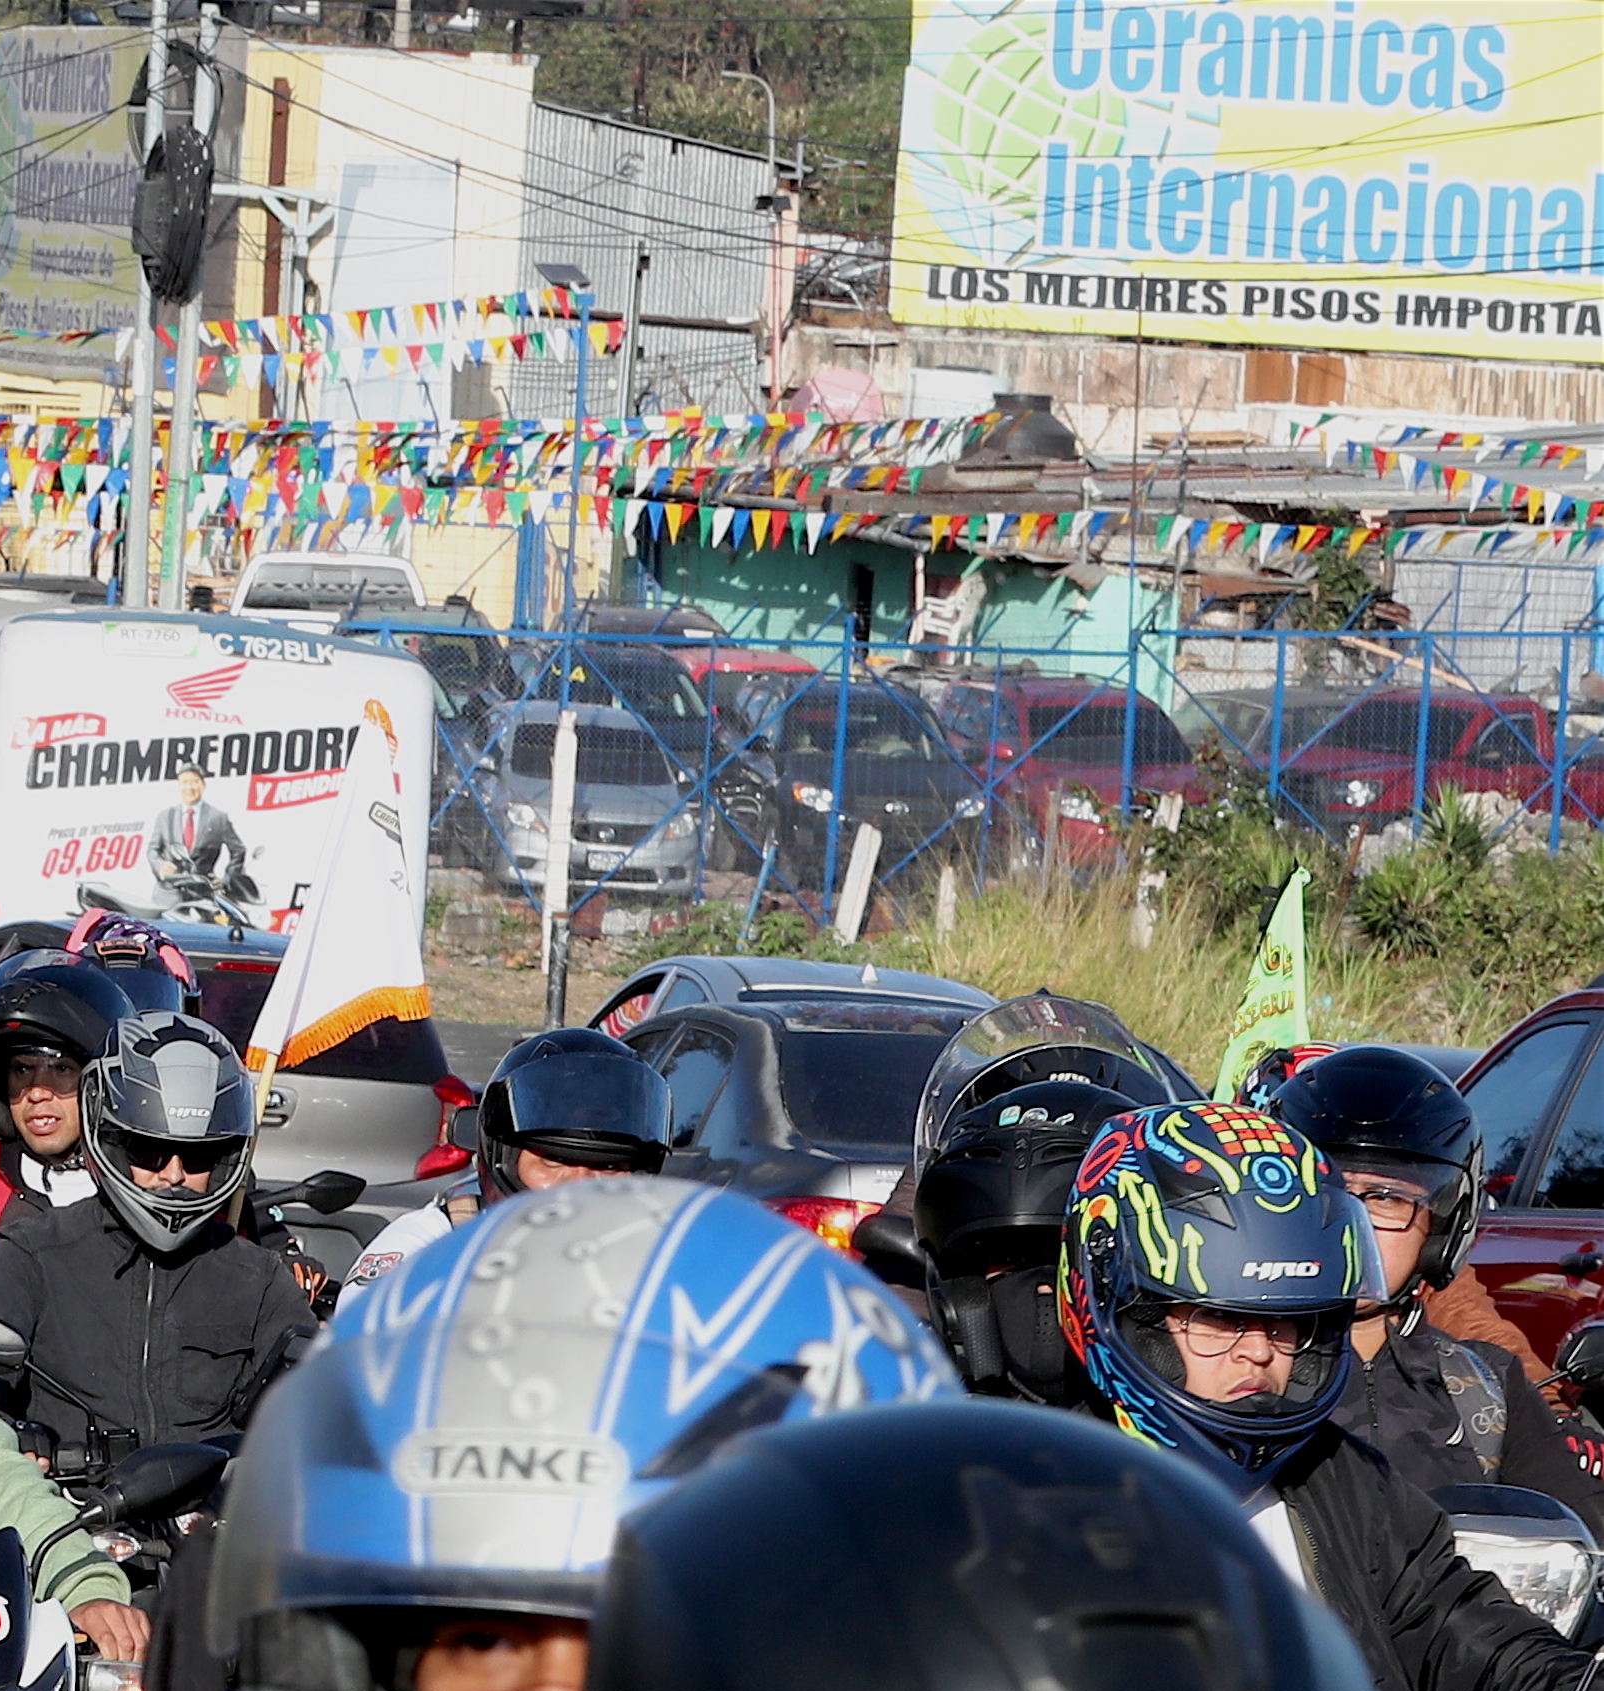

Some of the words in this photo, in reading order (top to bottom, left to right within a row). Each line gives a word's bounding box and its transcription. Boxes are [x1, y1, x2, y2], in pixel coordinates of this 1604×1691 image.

[1042, 142, 1604, 276] Internacional
[928, 265, 1011, 303] LOS
[1026, 272, 1228, 317] MEJORES
[1242, 285, 1380, 324] PISOS
[1395, 294, 1603, 338] IMPORTA
[120, 628, 181, 642] RT-7760
[213, 633, 235, 656] C
[239, 635, 335, 665] 762BLK
[165, 707, 244, 726] HONDA
[255, 782, 273, 807] Y
[41, 834, 144, 879] Q9,690
[168, 1107, 211, 1118] HRO
[1242, 1261, 1321, 1282] HRO
[425, 1445, 605, 1484] TANKE
